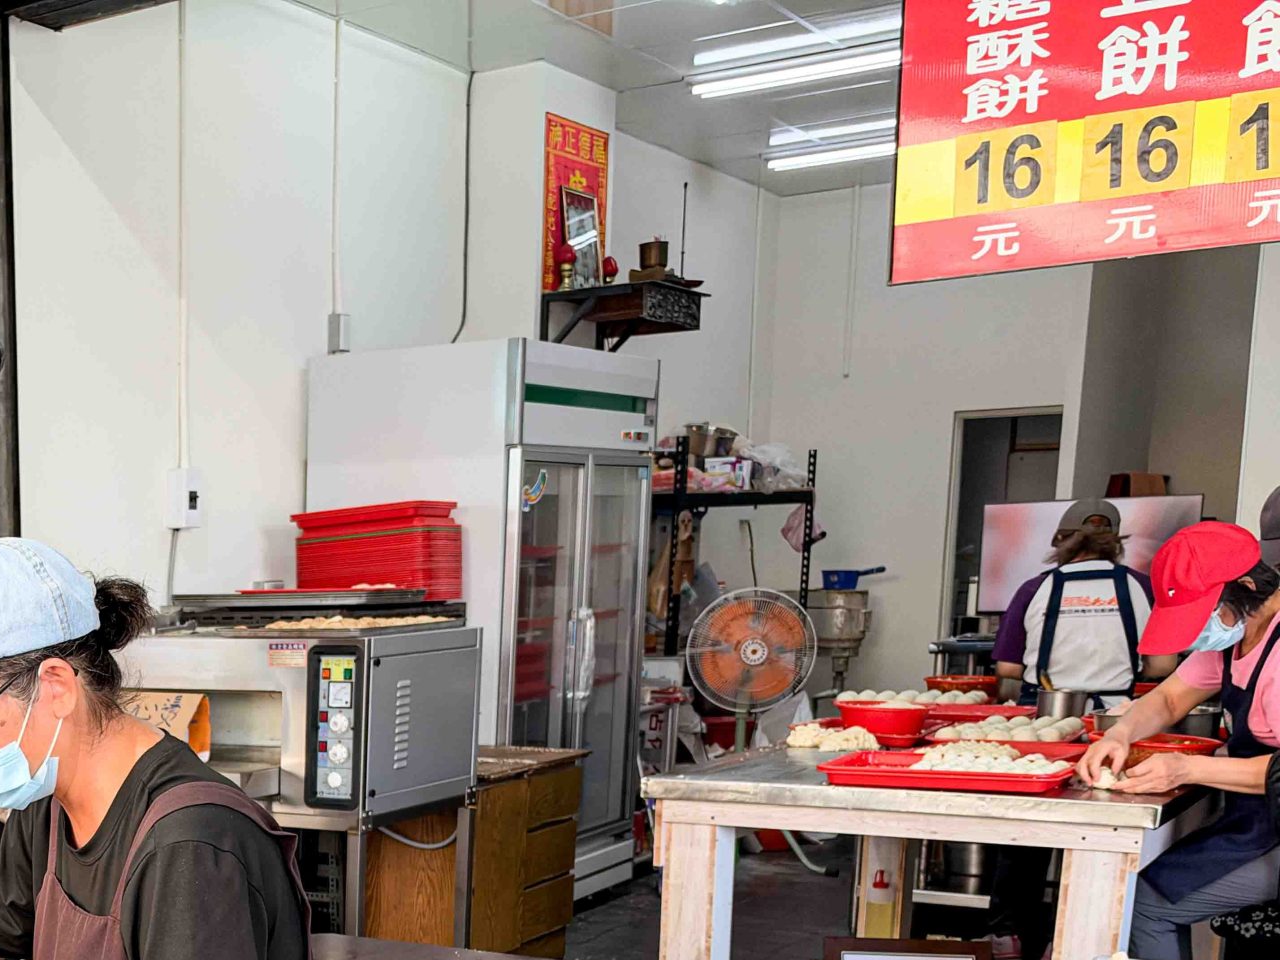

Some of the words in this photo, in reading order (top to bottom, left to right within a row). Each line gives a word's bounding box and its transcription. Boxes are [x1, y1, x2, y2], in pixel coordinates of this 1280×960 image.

[964, 134, 1043, 205] 16
[1095, 115, 1179, 189] 16
[971, 222, 1020, 260] 元
[1104, 205, 1157, 244] 元
